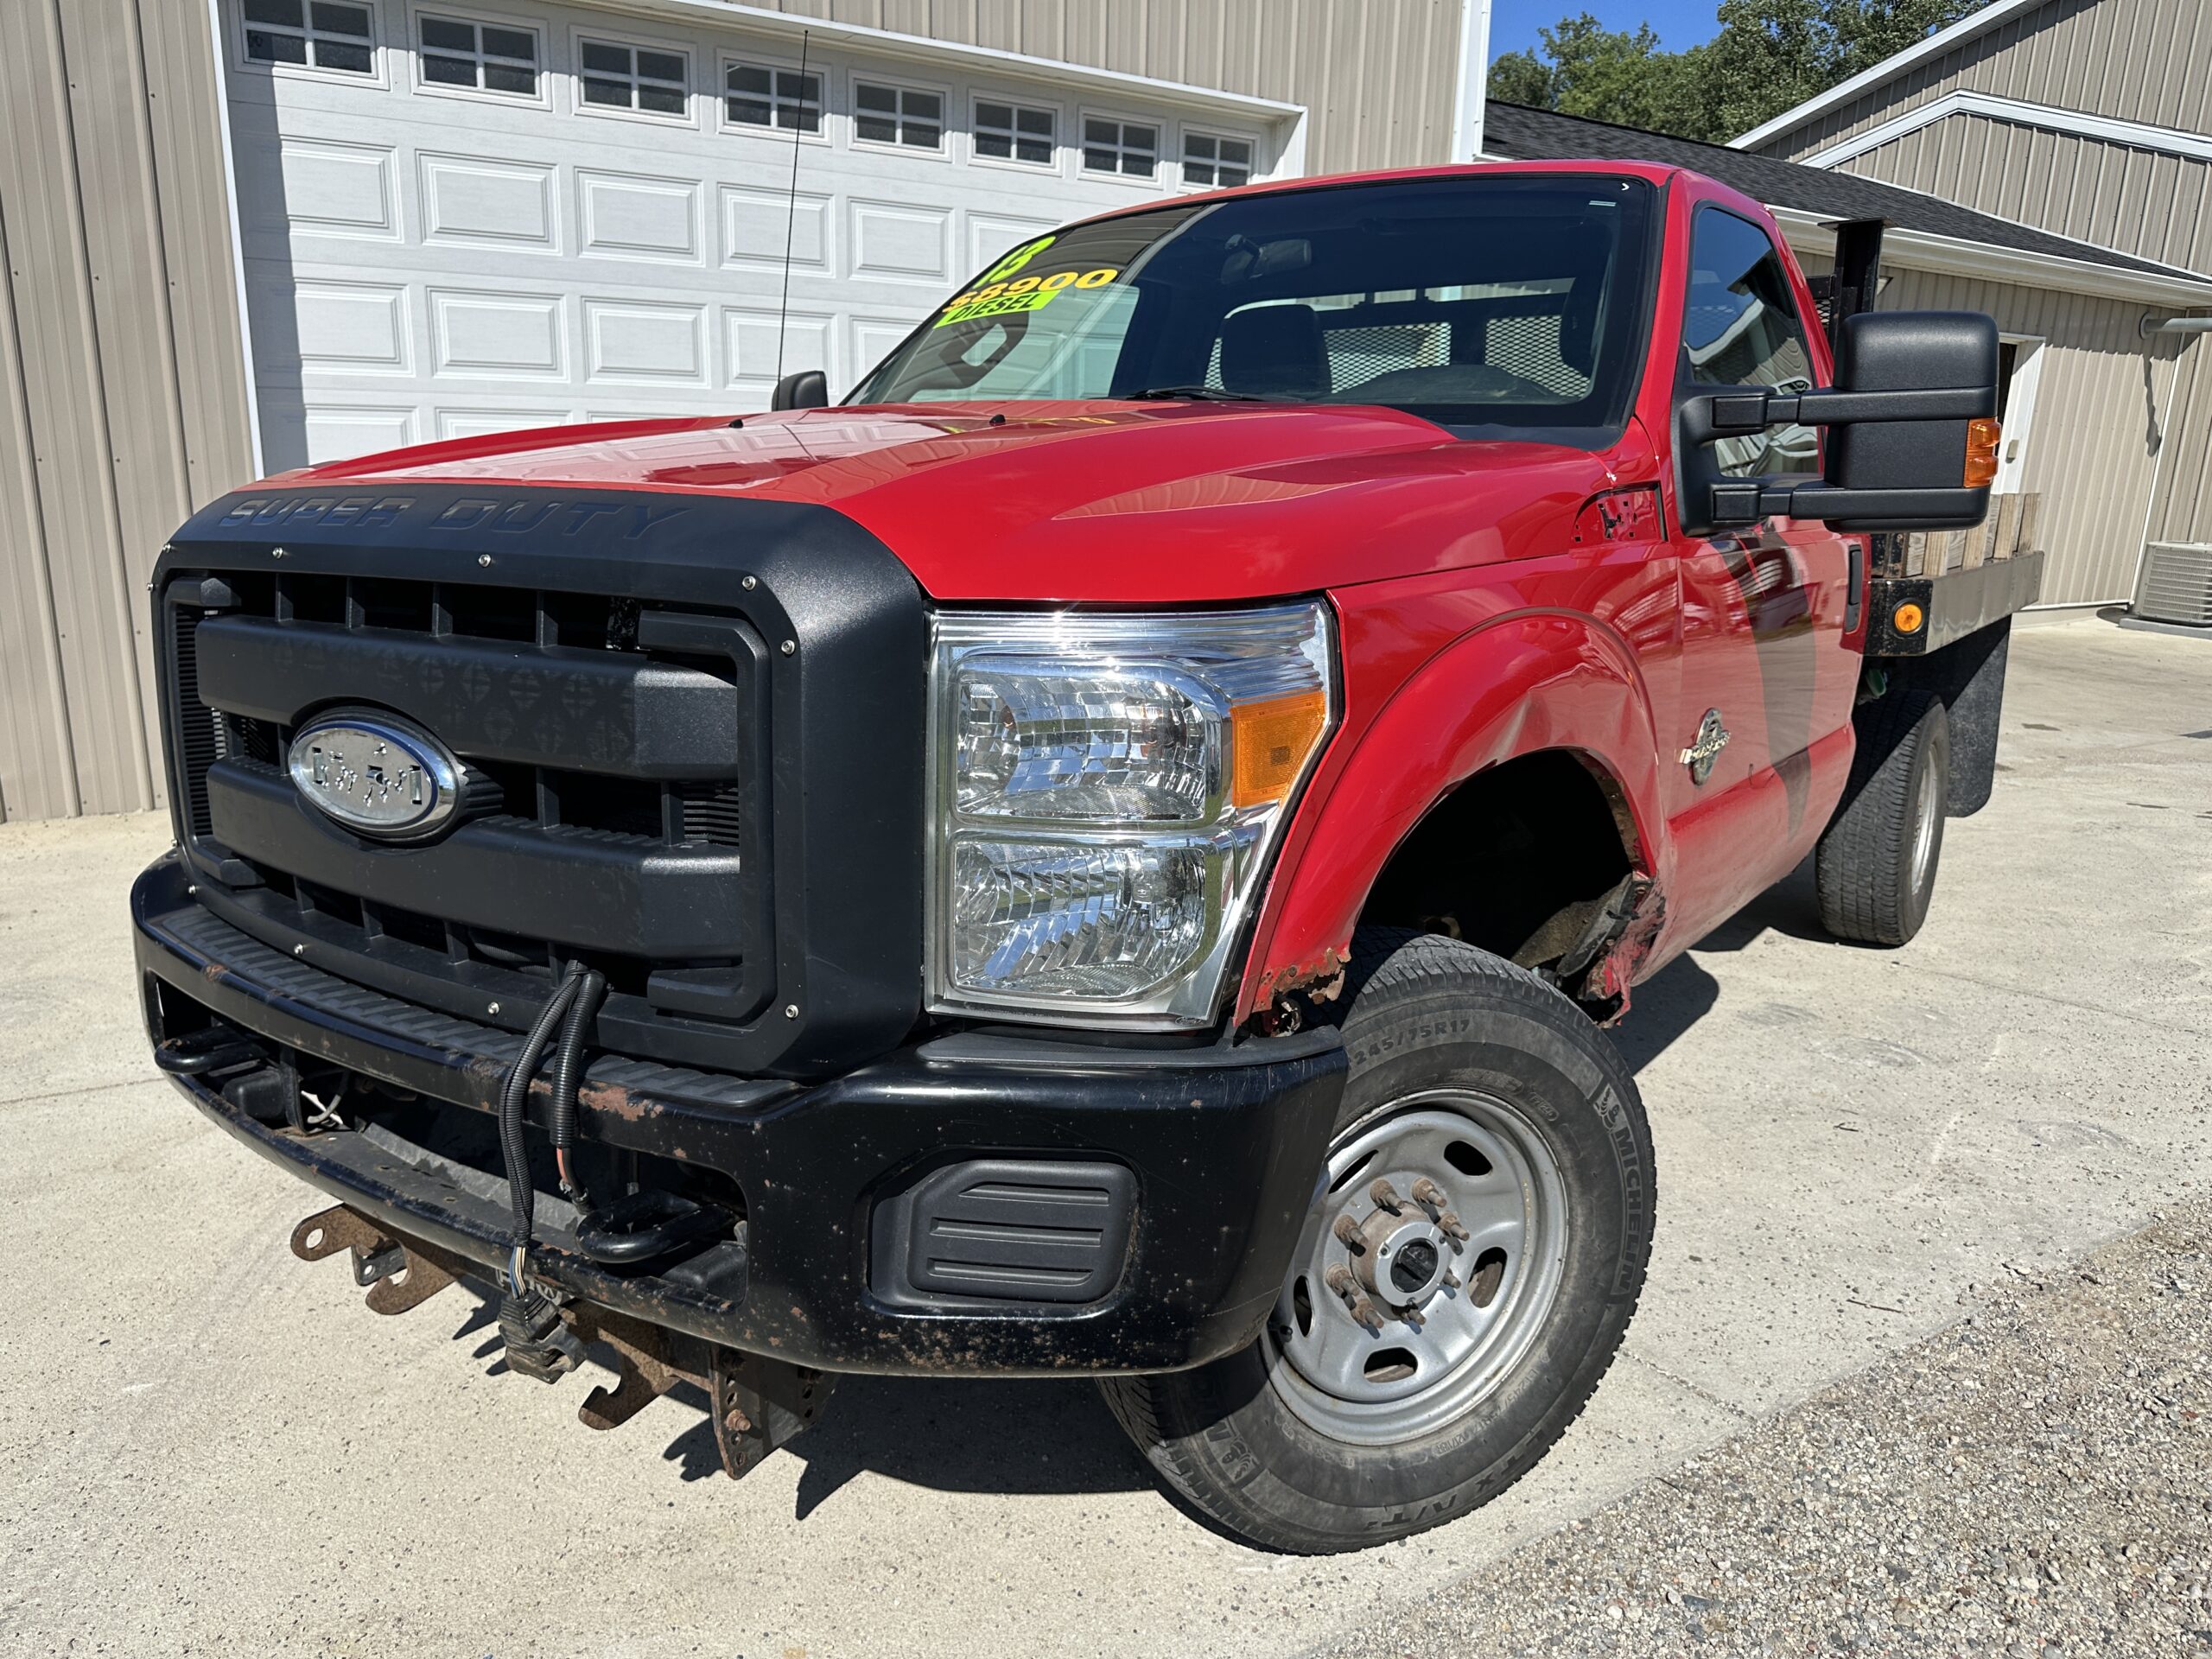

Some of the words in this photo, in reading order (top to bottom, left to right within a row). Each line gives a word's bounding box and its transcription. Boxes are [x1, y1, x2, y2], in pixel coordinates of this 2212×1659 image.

[972, 235, 1056, 289] 13
[942, 269, 1118, 313] $8900
[946, 293, 1041, 322] DIESEL
[219, 497, 416, 527] SUPER
[429, 498, 690, 539] DUTY
[1614, 1126, 1642, 1292] MICHELIN
[1474, 1427, 1545, 1494] LTX
